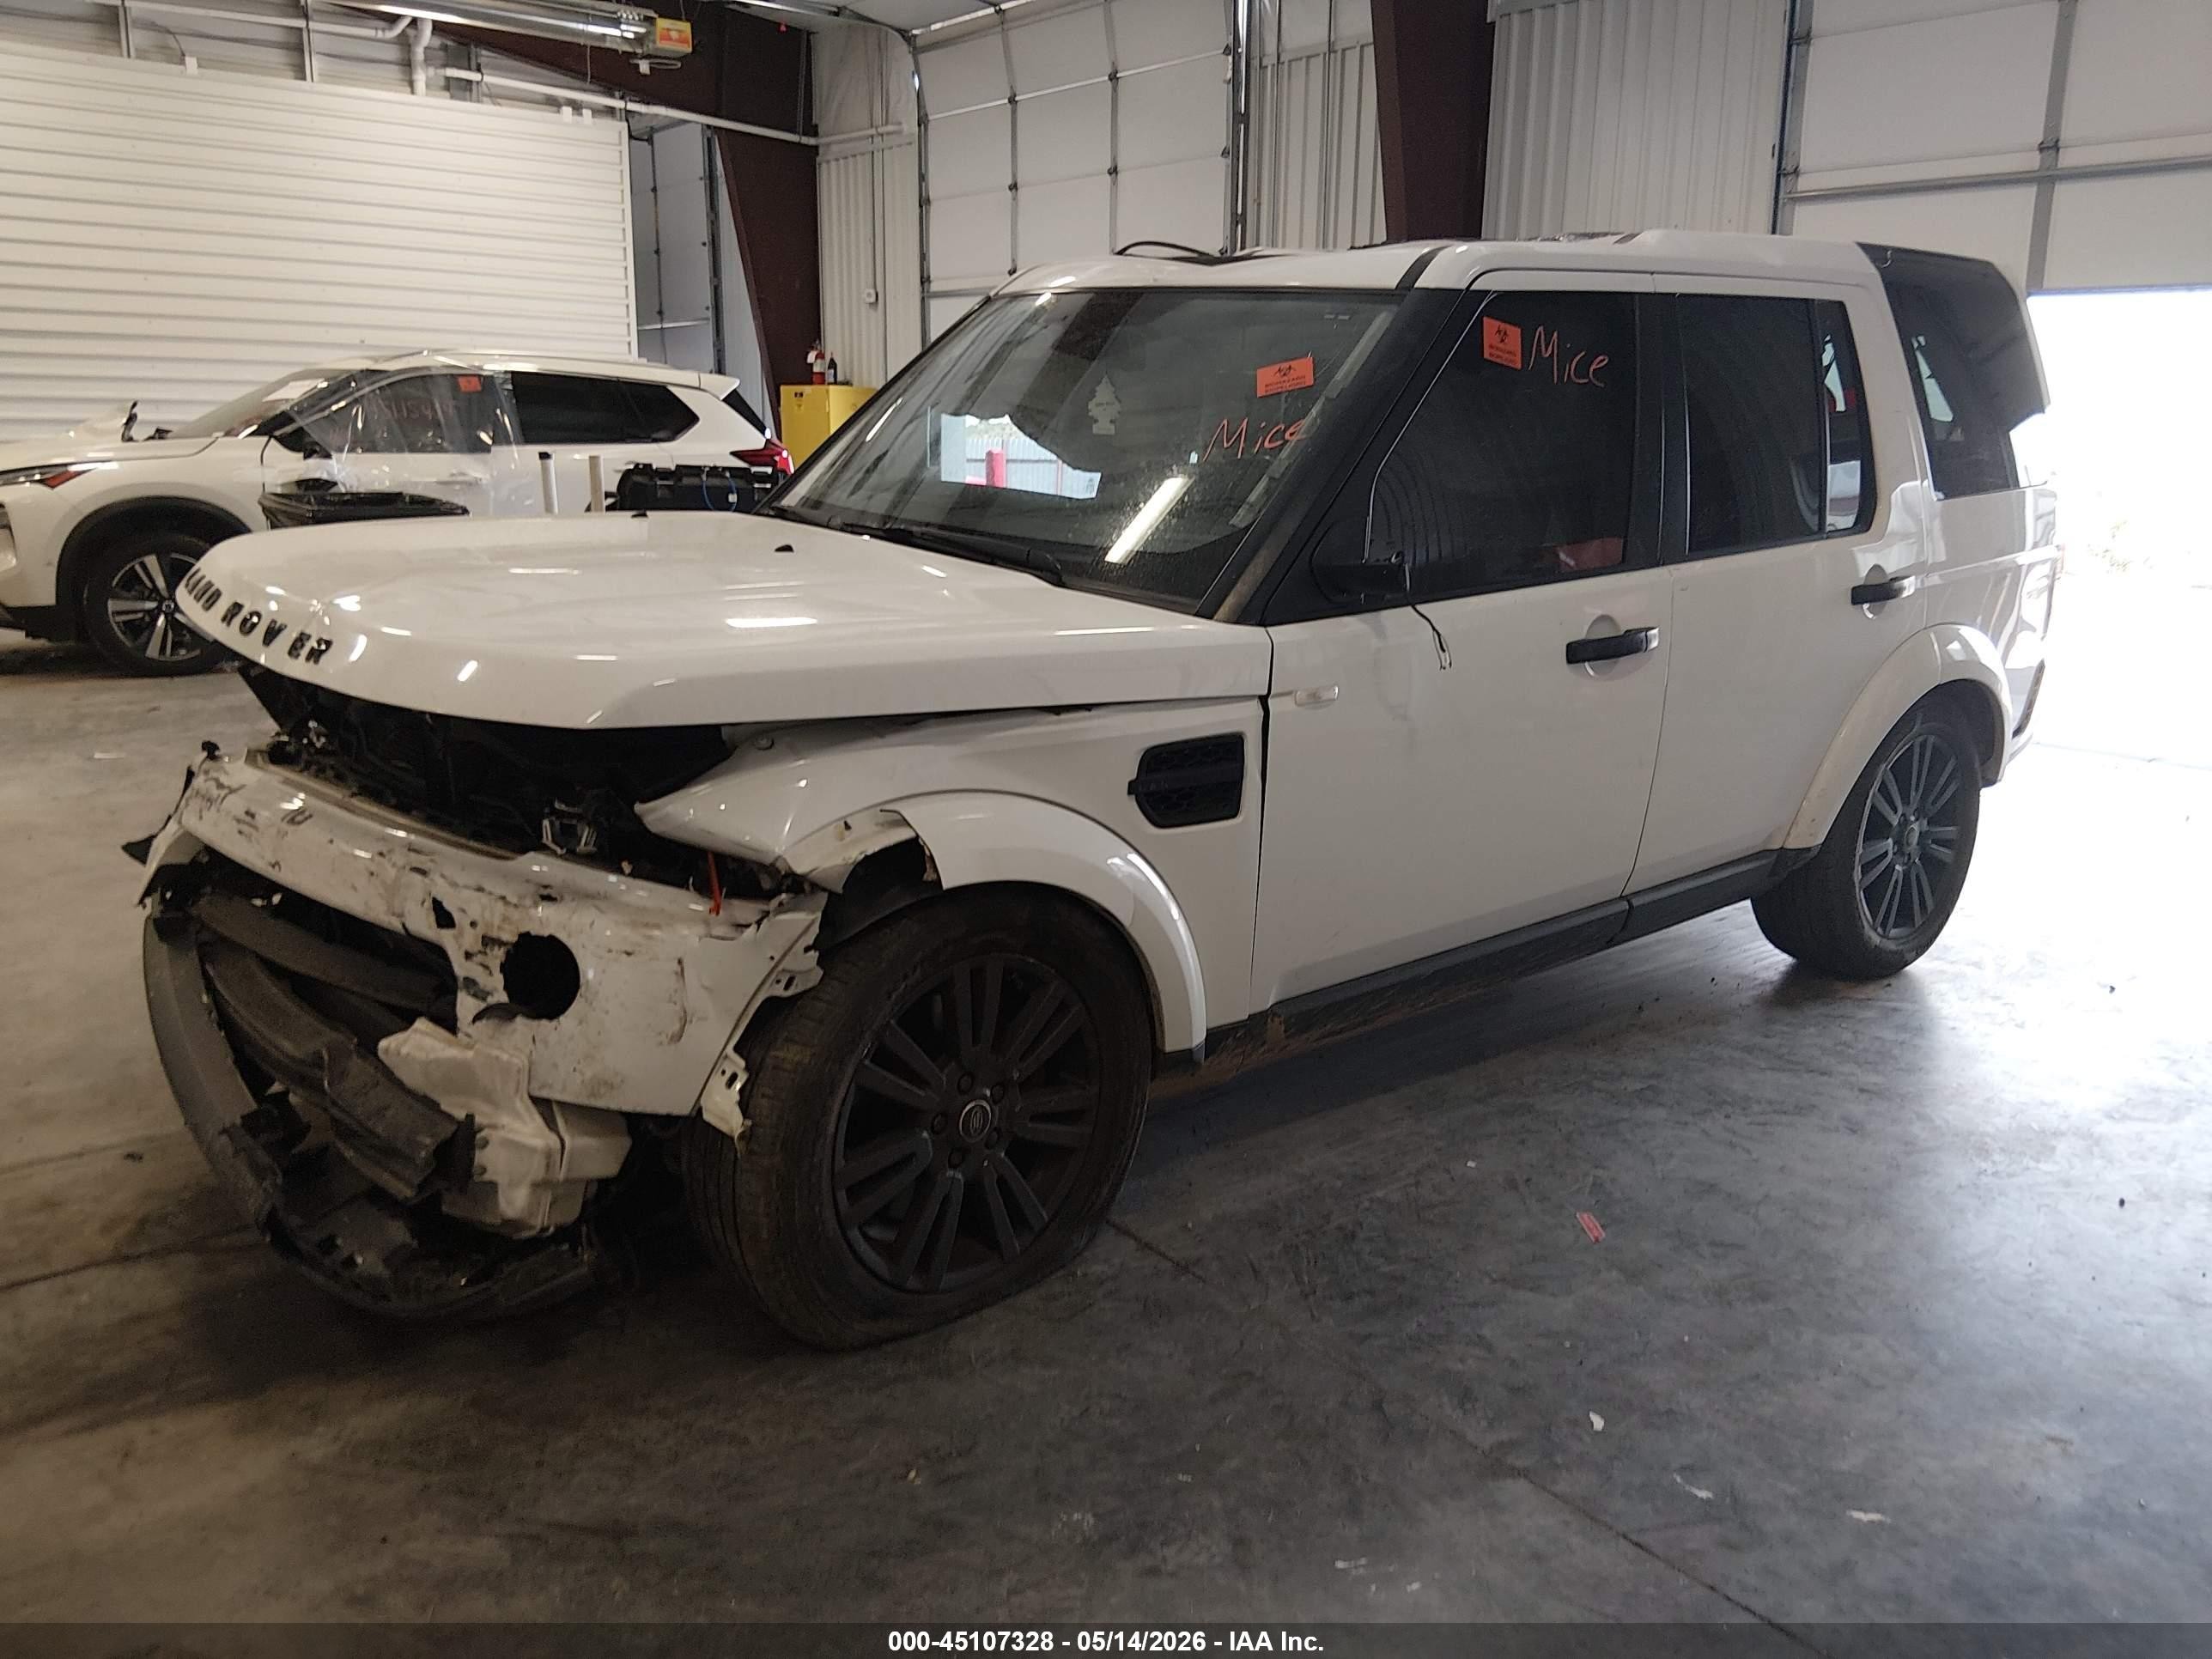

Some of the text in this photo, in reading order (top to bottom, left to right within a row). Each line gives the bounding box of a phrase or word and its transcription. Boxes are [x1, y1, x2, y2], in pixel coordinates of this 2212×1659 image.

[1528, 325, 1608, 387] Mice
[1202, 417, 1306, 461] Mice
[221, 601, 333, 665] ROVER
